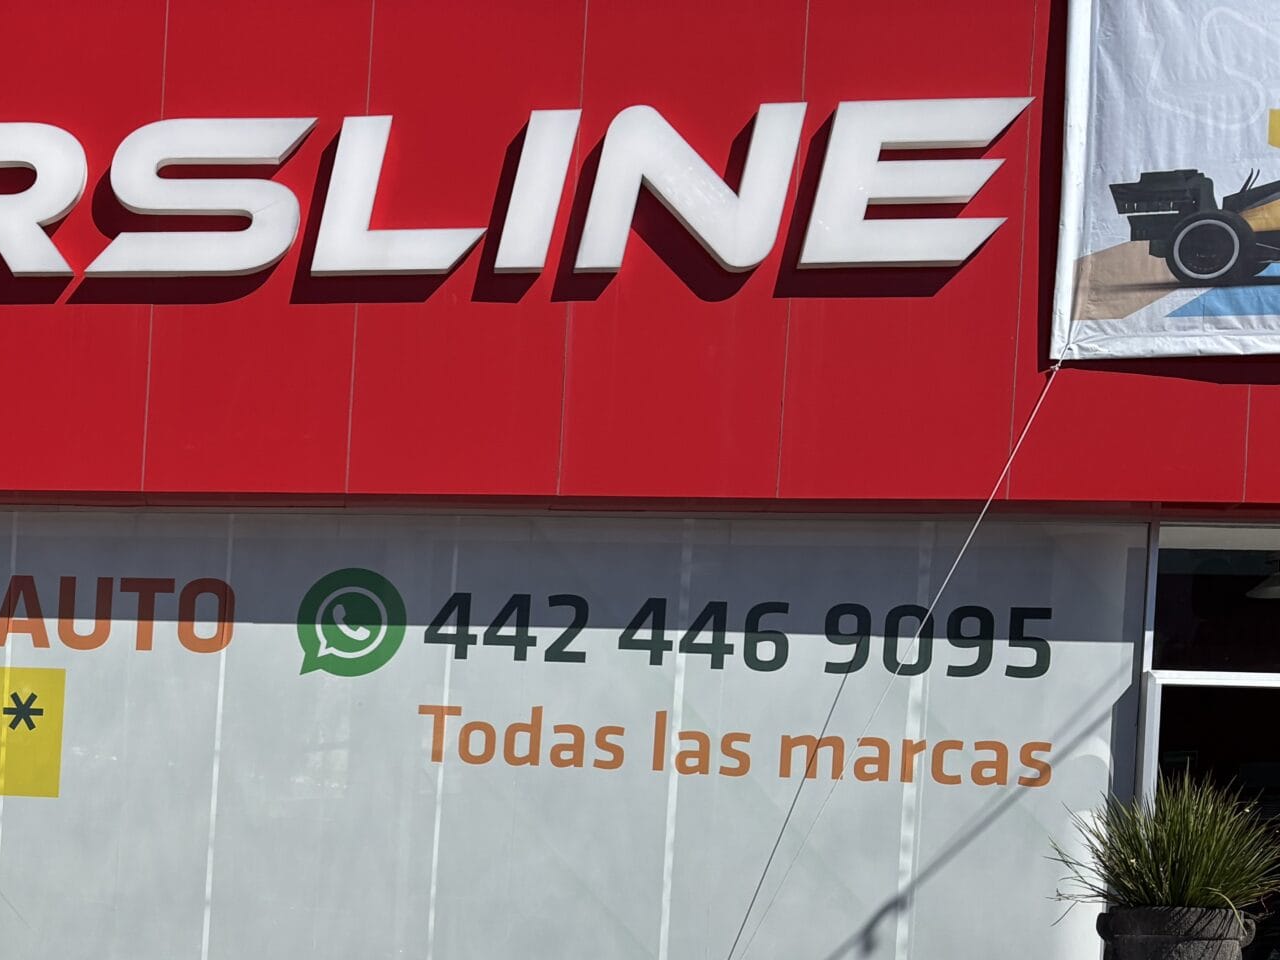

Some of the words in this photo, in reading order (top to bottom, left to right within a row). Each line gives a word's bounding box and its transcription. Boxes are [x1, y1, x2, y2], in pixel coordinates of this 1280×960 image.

[424, 592, 589, 664] 442
[618, 597, 790, 671] 446
[823, 602, 1054, 680] 9095
[418, 705, 625, 770] Todas
[652, 711, 751, 778] las
[779, 733, 1053, 789] marcas
